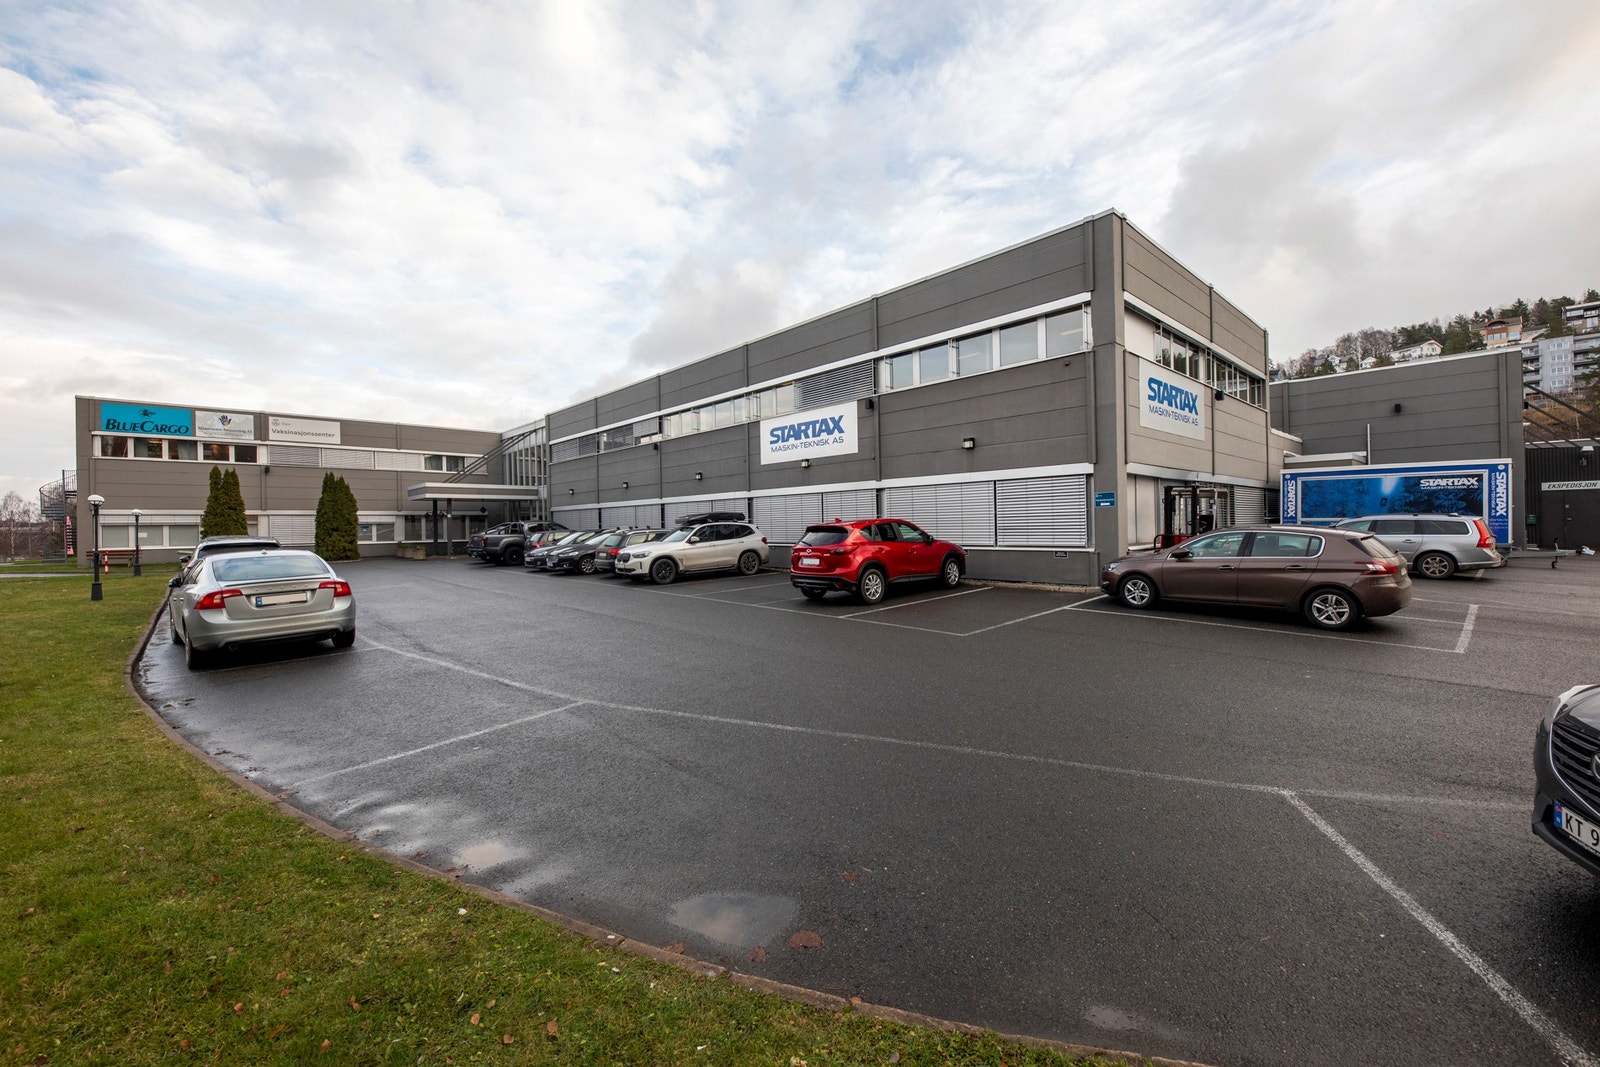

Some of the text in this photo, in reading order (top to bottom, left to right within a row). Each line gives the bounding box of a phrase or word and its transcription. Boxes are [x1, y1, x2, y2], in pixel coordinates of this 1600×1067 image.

[1147, 376, 1199, 416] STARTAX
[1148, 404, 1199, 426] MASKIN-TEKNISK AS
[271, 428, 336, 438] Vaksinasjonssenter
[769, 415, 845, 445] STARTAX
[770, 436, 844, 453] MASKIN-TEKNISK AS
[1420, 477, 1479, 487] STARTAX
[1496, 471, 1507, 517] STARTAX
[1287, 480, 1296, 517] STARTAX
[1565, 812, 1584, 837] KT
